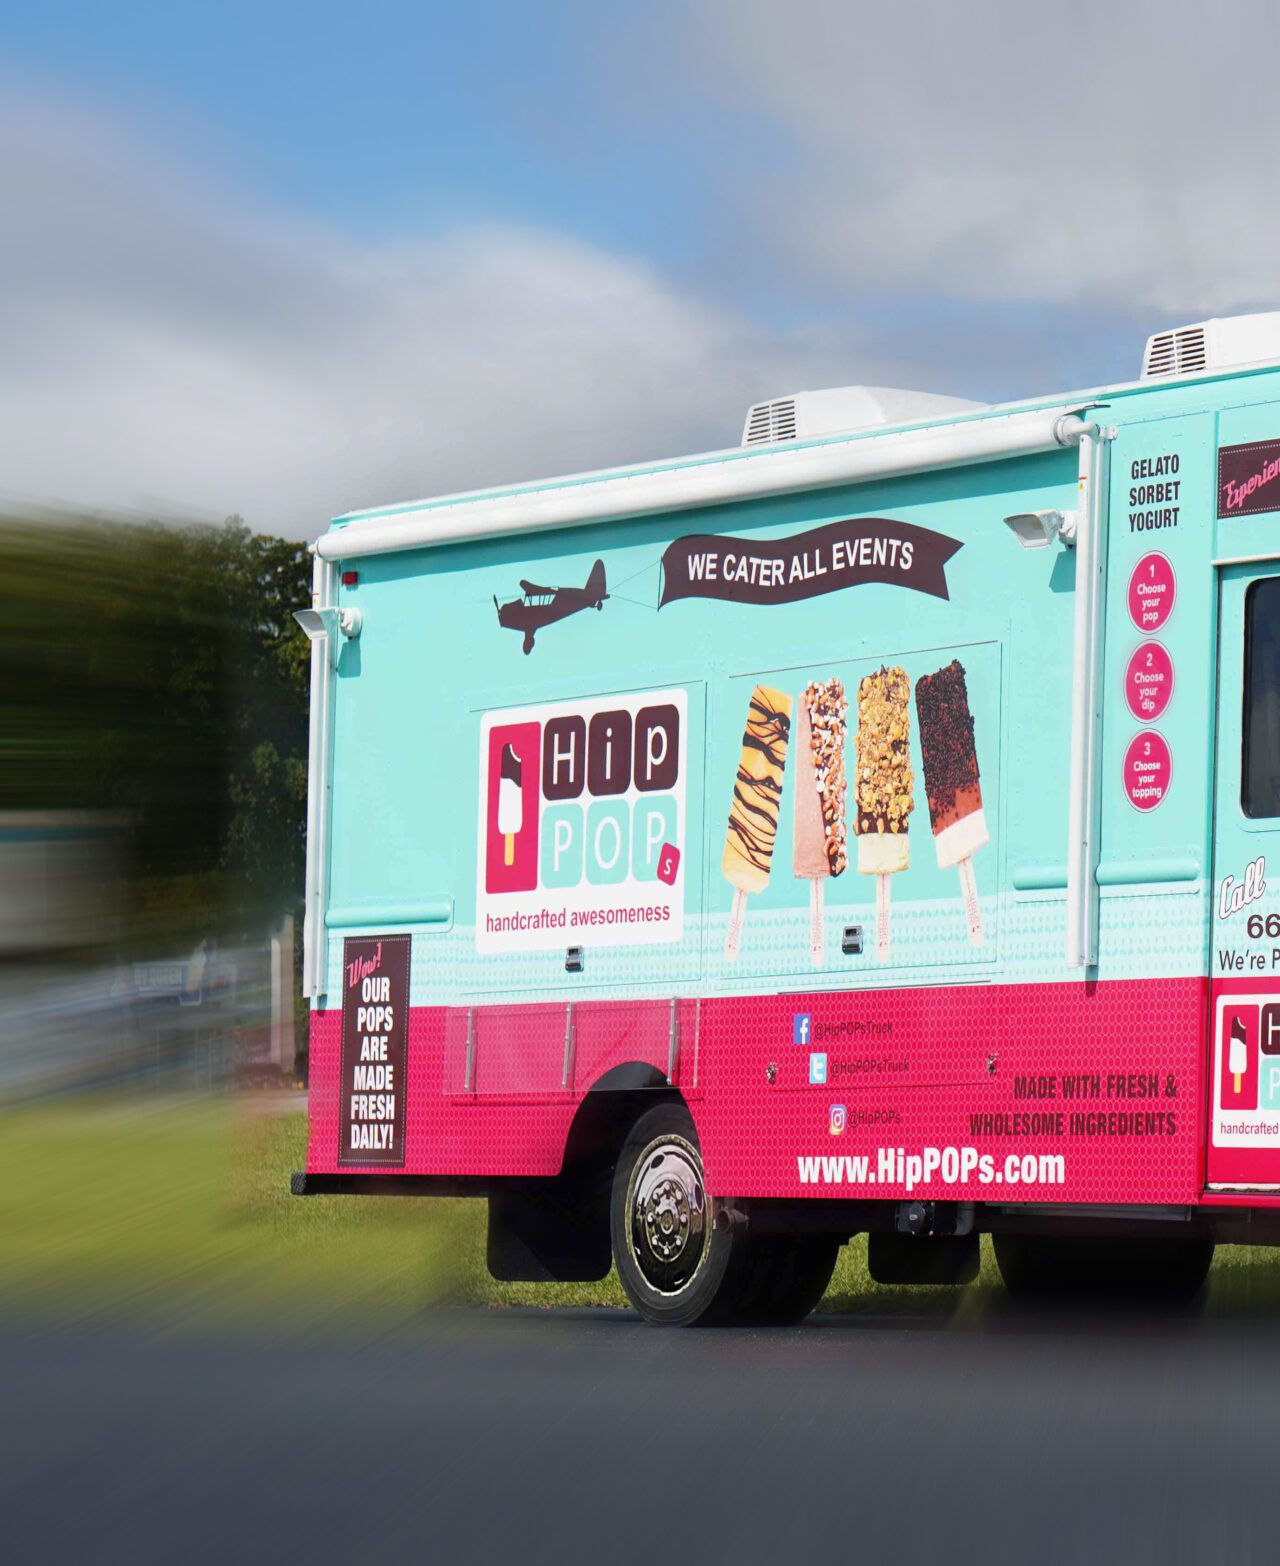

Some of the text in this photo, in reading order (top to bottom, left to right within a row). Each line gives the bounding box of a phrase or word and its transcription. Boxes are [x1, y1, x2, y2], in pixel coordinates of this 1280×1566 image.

[1131, 454, 1180, 480] GELATO
[1129, 481, 1181, 507] SORBET
[1128, 508, 1180, 533] YOGURT
[688, 538, 914, 586] WE CATER ALL EVENTS
[1149, 564, 1155, 578] 1
[1137, 583, 1166, 595] Choose
[1142, 598, 1160, 611] your
[1143, 611, 1159, 624] pop
[1146, 653, 1153, 667] 2
[1134, 672, 1164, 684] Choose
[1139, 687, 1158, 700] your
[1141, 698, 1155, 712] dip
[553, 725, 668, 785] Hip
[1144, 742, 1151, 756] 3
[1133, 760, 1161, 772] Choose
[1138, 774, 1156, 786] your
[1132, 786, 1162, 799] topping
[1219, 856, 1266, 920] Call
[486, 905, 670, 933] handcrafted awesomeness
[346, 942, 382, 988] Wow!
[1219, 949, 1266, 970] We're
[362, 977, 390, 1003] OUR
[357, 1006, 393, 1032] POPS
[815, 1021, 893, 1040] @HipPOPsTruck
[360, 1036, 388, 1061] ARE
[353, 1065, 393, 1091] MADE
[831, 1059, 909, 1077] @HipPOPsTruck
[1014, 1074, 1177, 1099] MADE WITH FRESH &
[351, 1095, 395, 1120] FRESH
[848, 1110, 900, 1128] @HipPOPs
[969, 1112, 1176, 1136] WHOLESOME INGREDIENTS
[1220, 1122, 1279, 1135] handcrafted
[351, 1124, 393, 1149] DAILY!
[797, 1147, 1065, 1191] www.HipPOPs.com
